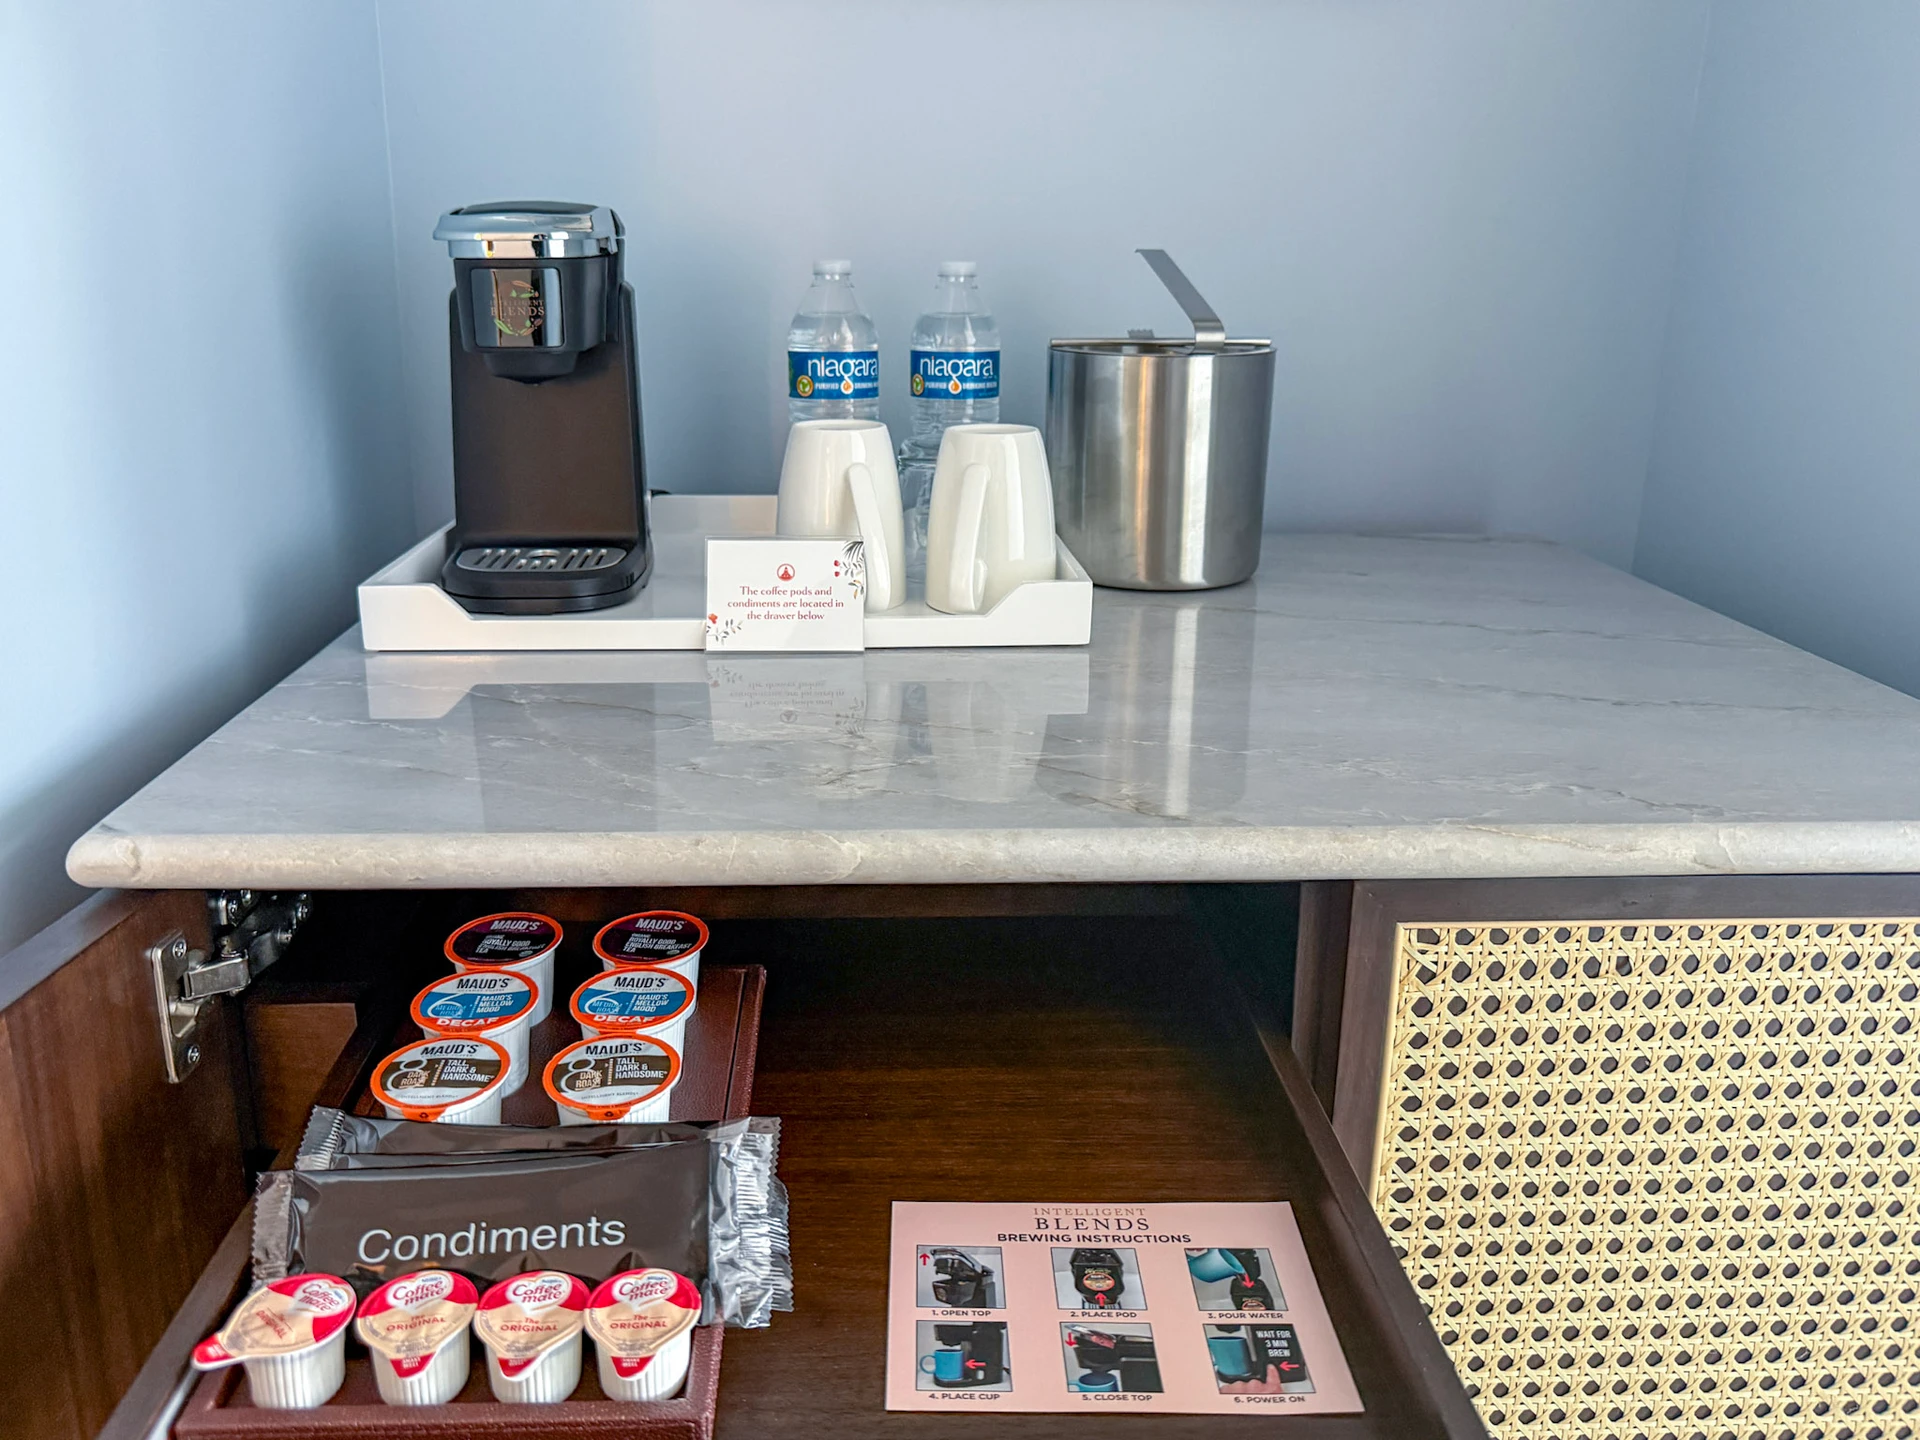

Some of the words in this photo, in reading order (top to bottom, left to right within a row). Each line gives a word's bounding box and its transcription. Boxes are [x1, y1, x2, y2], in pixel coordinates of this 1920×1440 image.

[491, 306, 545, 316] BLENDS
[807, 356, 878, 381] niagara
[920, 356, 993, 381] niagara
[740, 586, 759, 596] The
[760, 586, 788, 596] coffee
[790, 586, 812, 597] pods
[814, 586, 832, 596] and
[728, 600, 780, 608] condiments
[782, 600, 798, 608] are
[800, 600, 834, 608] located
[836, 600, 844, 608] in
[747, 612, 763, 620] the
[764, 612, 796, 620] drawer
[797, 612, 825, 620] below
[490, 920, 541, 930] MAUD'S
[635, 918, 685, 930] MAUD'S
[456, 978, 510, 989] MAUD'S
[614, 976, 666, 988] MAUD'S
[436, 1017, 500, 1027] DECAF
[593, 1015, 655, 1023] DECAF
[420, 1044, 479, 1055] MAUD'S
[585, 1043, 643, 1055] MAUD'S
[616, 1064, 640, 1072] DARK
[407, 1070, 430, 1079] DARK
[580, 1070, 602, 1079] DARK
[1034, 1208, 1146, 1216] INTELLIGENT
[1035, 1218, 1150, 1231] BLENDS
[358, 1216, 626, 1264] Condiments
[998, 1233, 1072, 1243] BREWING
[1077, 1234, 1192, 1243] INSTRUCTIONS
[393, 1280, 443, 1300] Coffee
[512, 1284, 562, 1296] Coffee
[619, 1280, 668, 1296] Coffee
[302, 1284, 340, 1306] Coffee
[404, 1287, 444, 1305] mate
[522, 1290, 562, 1303] mate
[629, 1288, 668, 1301] mate
[298, 1296, 331, 1312] mate
[386, 1317, 447, 1332] ORIGINAL
[500, 1324, 558, 1332] ORIGINAL
[610, 1321, 667, 1329] ORIGINAL
[1256, 1330, 1274, 1338] WAIT
[1276, 1330, 1292, 1338] FOR
[1265, 1340, 1271, 1348] 3
[1272, 1340, 1288, 1348] MIN
[1268, 1349, 1290, 1357] BREW
